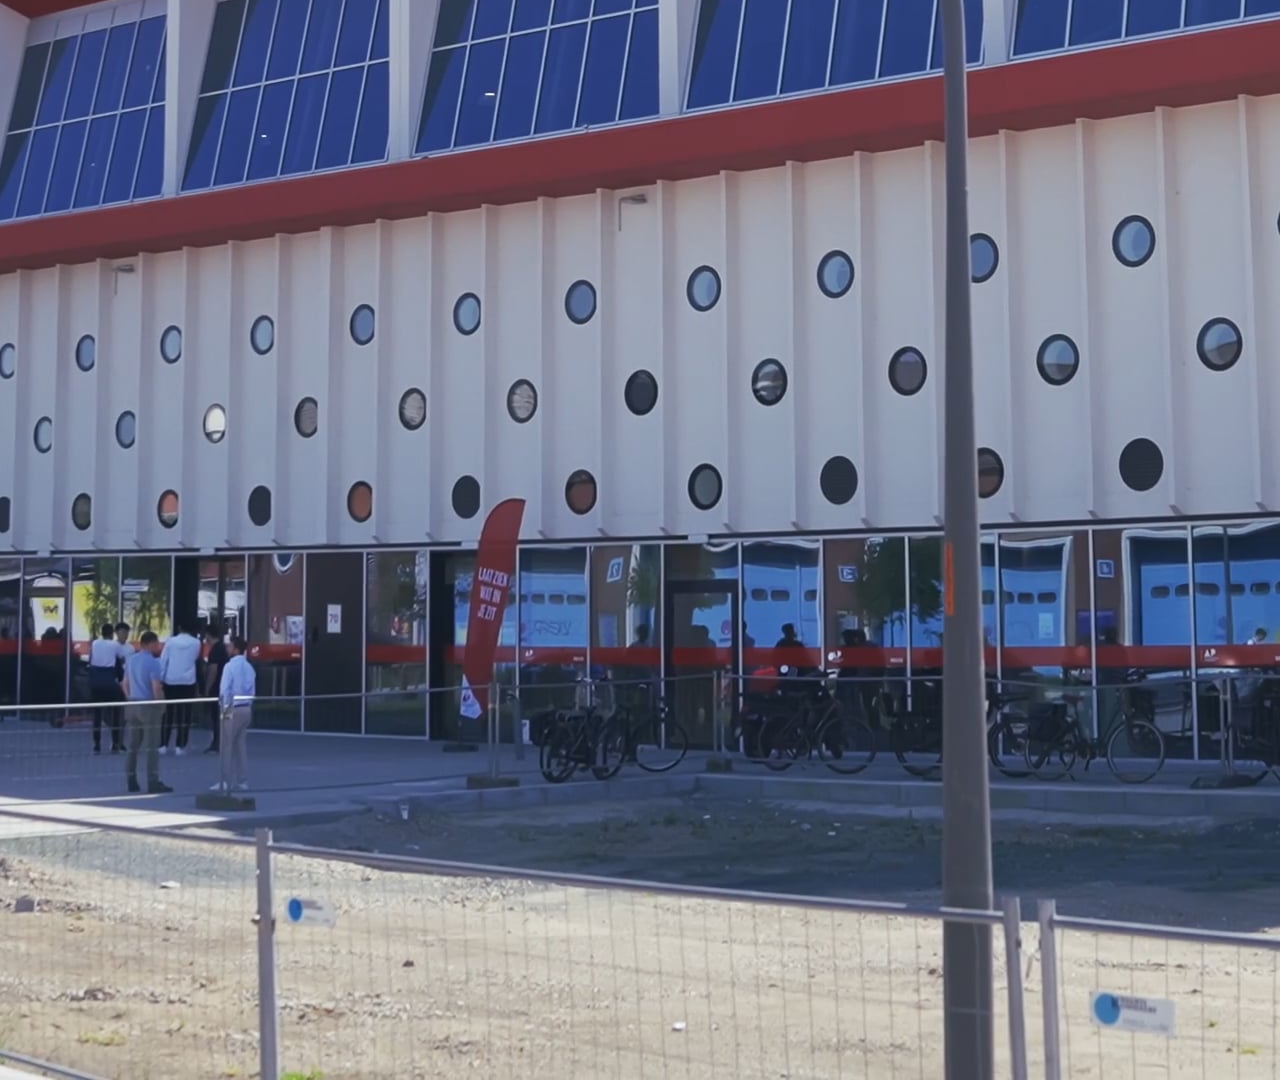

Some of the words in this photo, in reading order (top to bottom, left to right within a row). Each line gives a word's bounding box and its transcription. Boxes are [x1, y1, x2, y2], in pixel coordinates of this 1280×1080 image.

[478, 566, 494, 584] LAAT
[492, 570, 509, 587] ZIEN
[480, 585, 494, 601] WAT
[485, 605, 497, 621] ZIT
[1204, 648, 1216, 657] AP
